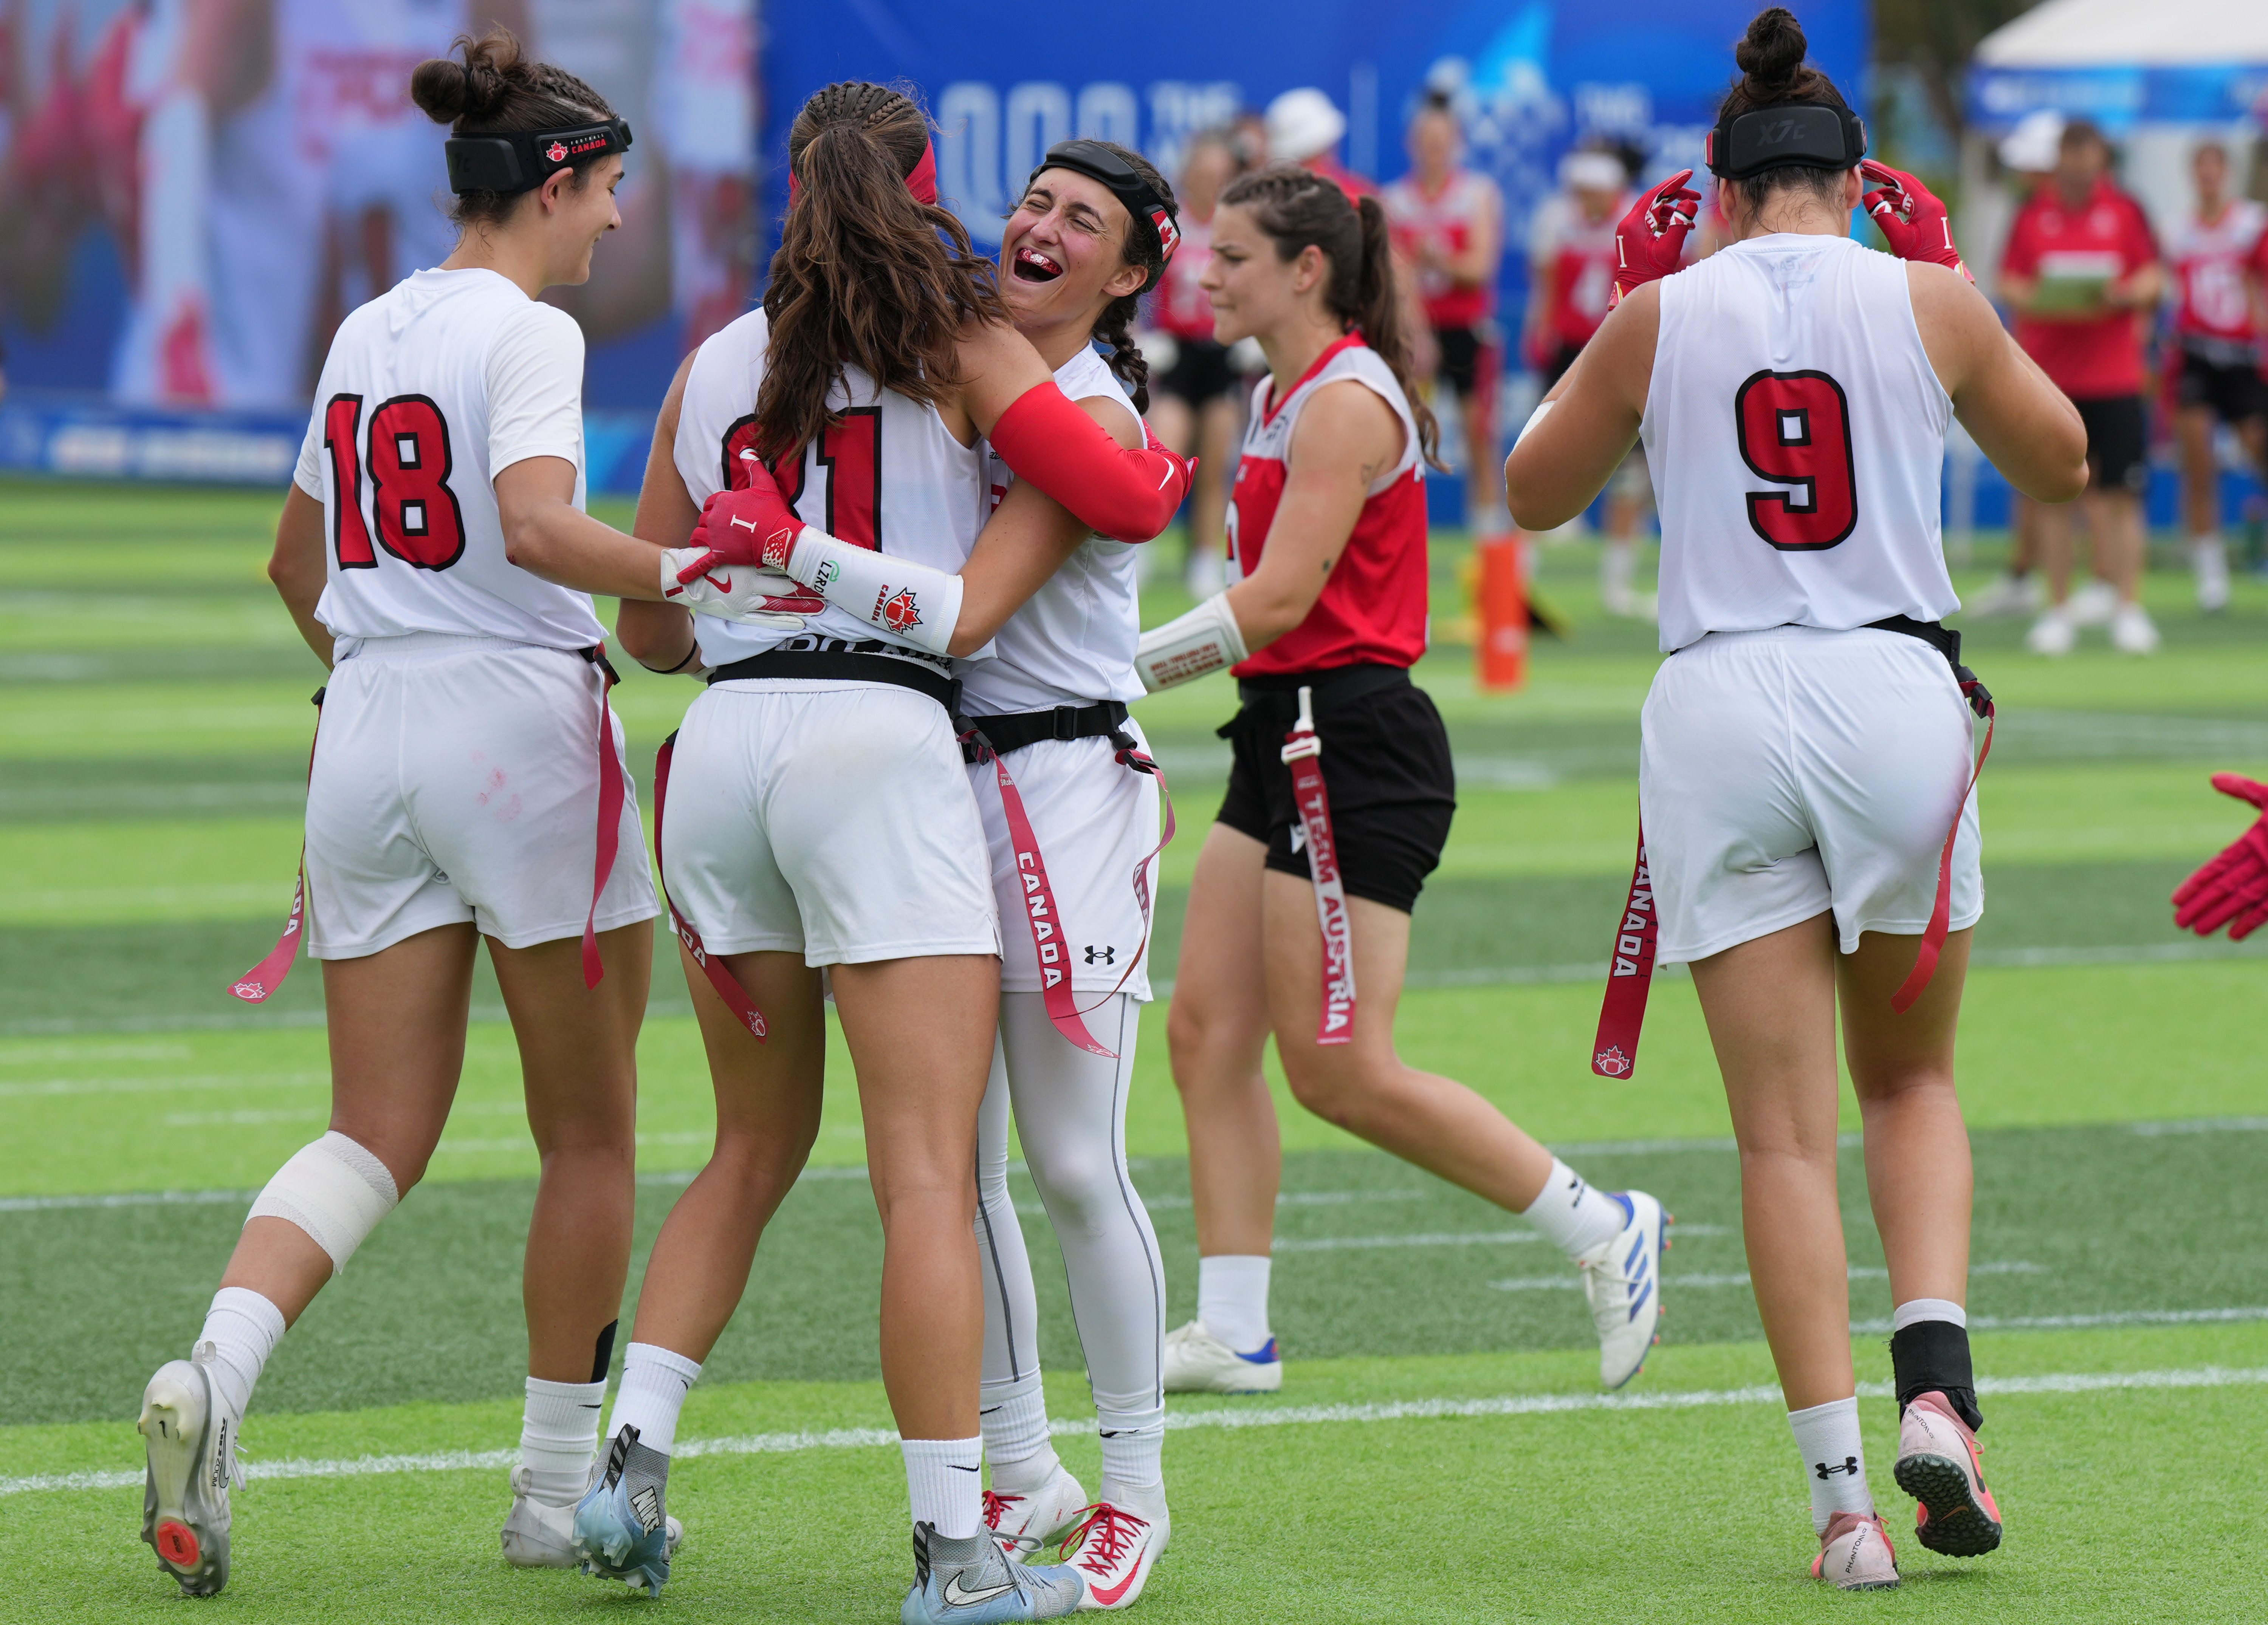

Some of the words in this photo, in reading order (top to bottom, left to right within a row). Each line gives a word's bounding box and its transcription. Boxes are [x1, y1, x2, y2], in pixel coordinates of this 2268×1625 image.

[570, 133, 604, 146] FOOTBALL
[571, 138, 606, 154] CANADA
[1735, 369, 1858, 551] 9
[324, 393, 466, 572] 18
[814, 561, 832, 593] LZRD
[871, 584, 889, 621] CANADA
[1018, 851, 1063, 990] CANADA
[1305, 793, 1334, 885] TEAM
[1324, 897, 1350, 1033] AUSTRIA
[211, 1458, 222, 1487] ZOOM
[631, 1486, 660, 1540] NIKE
[1845, 1534, 1866, 1574] PHANTOM
